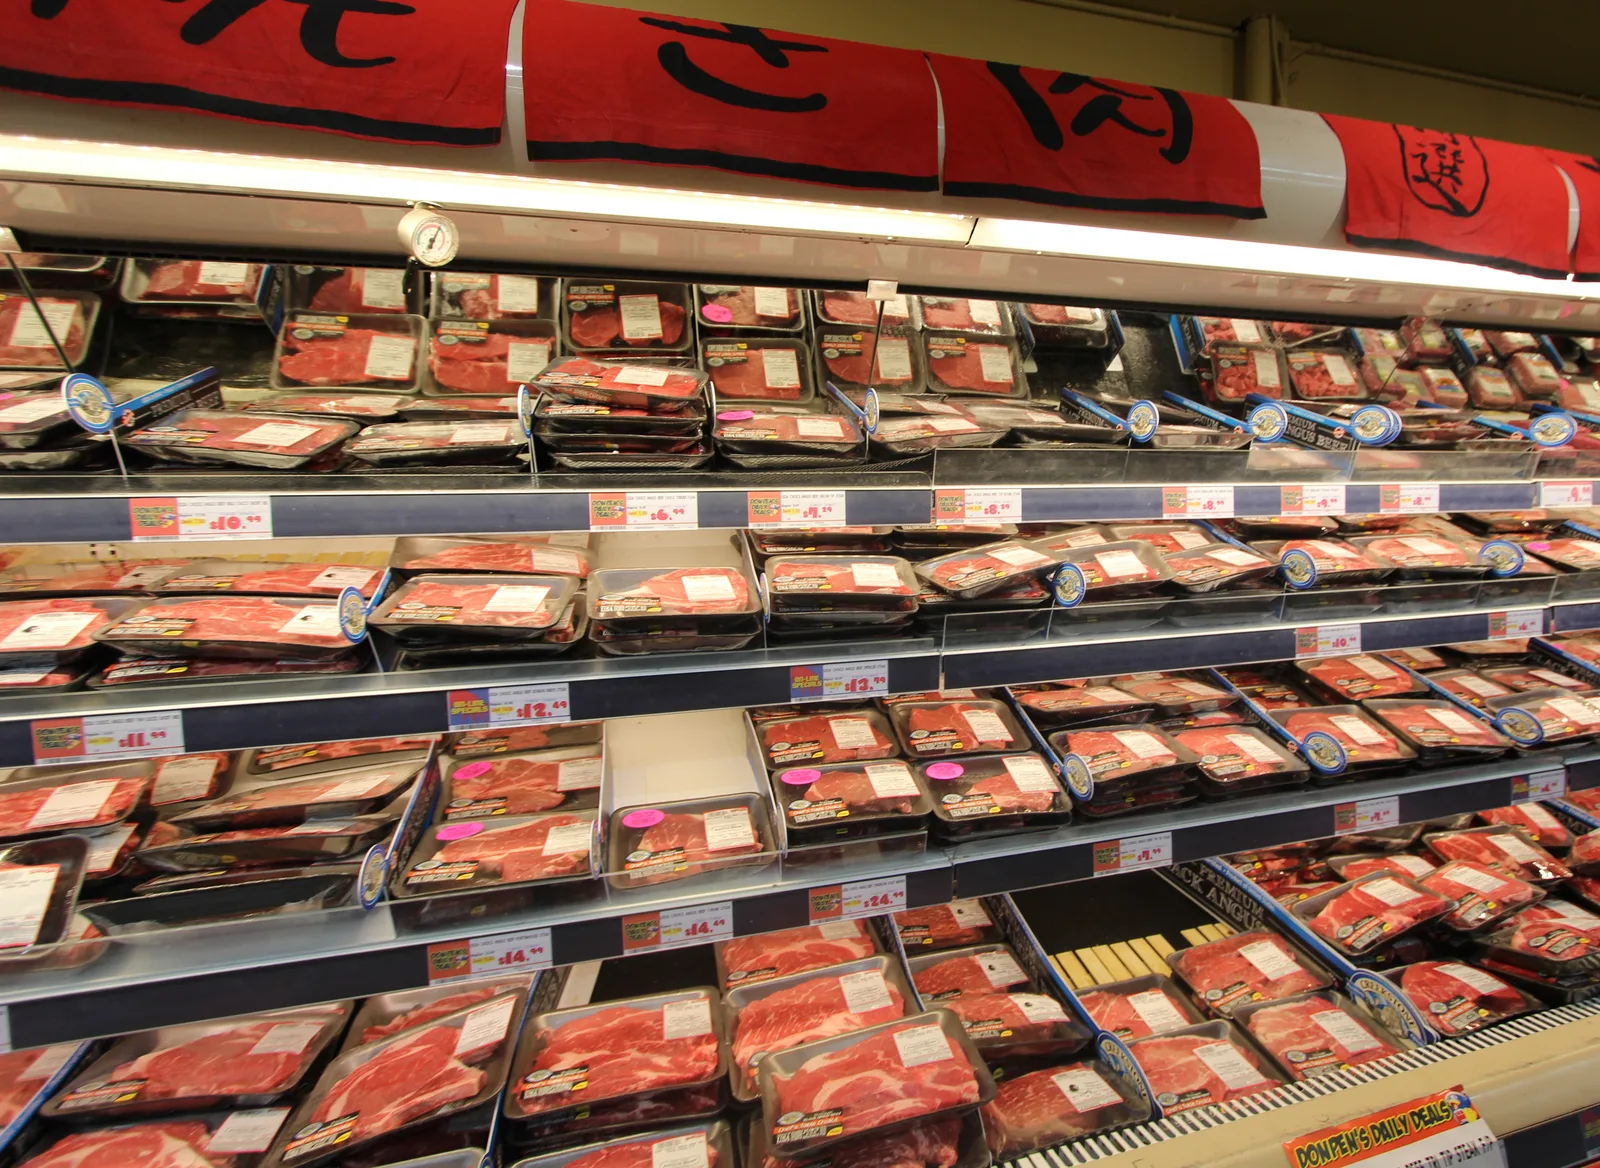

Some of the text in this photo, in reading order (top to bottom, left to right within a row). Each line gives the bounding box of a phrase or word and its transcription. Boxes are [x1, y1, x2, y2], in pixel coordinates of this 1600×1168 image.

[651, 508, 685, 520] $6.99
[803, 507, 832, 518] $7.29
[210, 515, 262, 530] $10.99
[516, 701, 567, 719] $12.49
[119, 731, 167, 747] $11.99
[864, 891, 904, 908] $24.99
[685, 919, 725, 936] $14.49
[498, 946, 544, 965] $14.99
[1295, 1099, 1453, 1168] DONPEN'S DAILY DEALS
